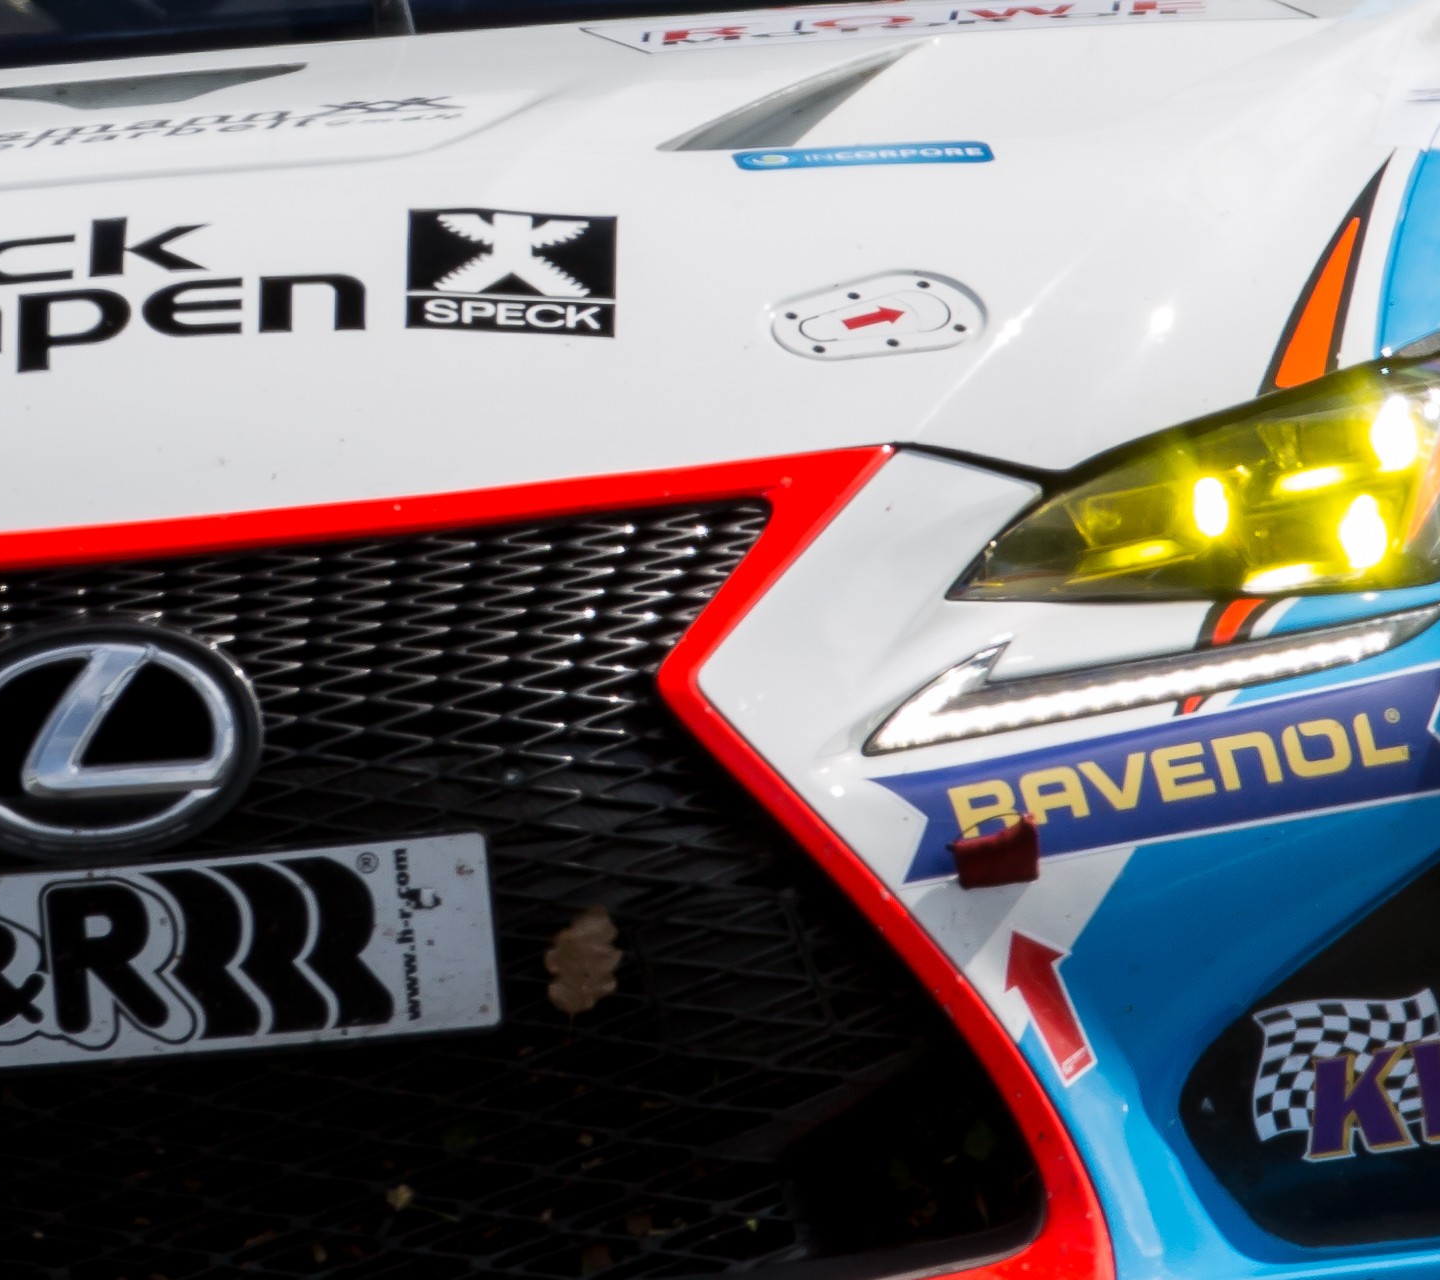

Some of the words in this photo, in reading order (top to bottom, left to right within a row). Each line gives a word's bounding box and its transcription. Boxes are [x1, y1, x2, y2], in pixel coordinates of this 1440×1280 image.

[802, 145, 986, 166] INCORPORE
[423, 299, 603, 332] SPECK
[946, 710, 1411, 840] RAVENOL
[392, 847, 422, 1021] www.h-r.com
